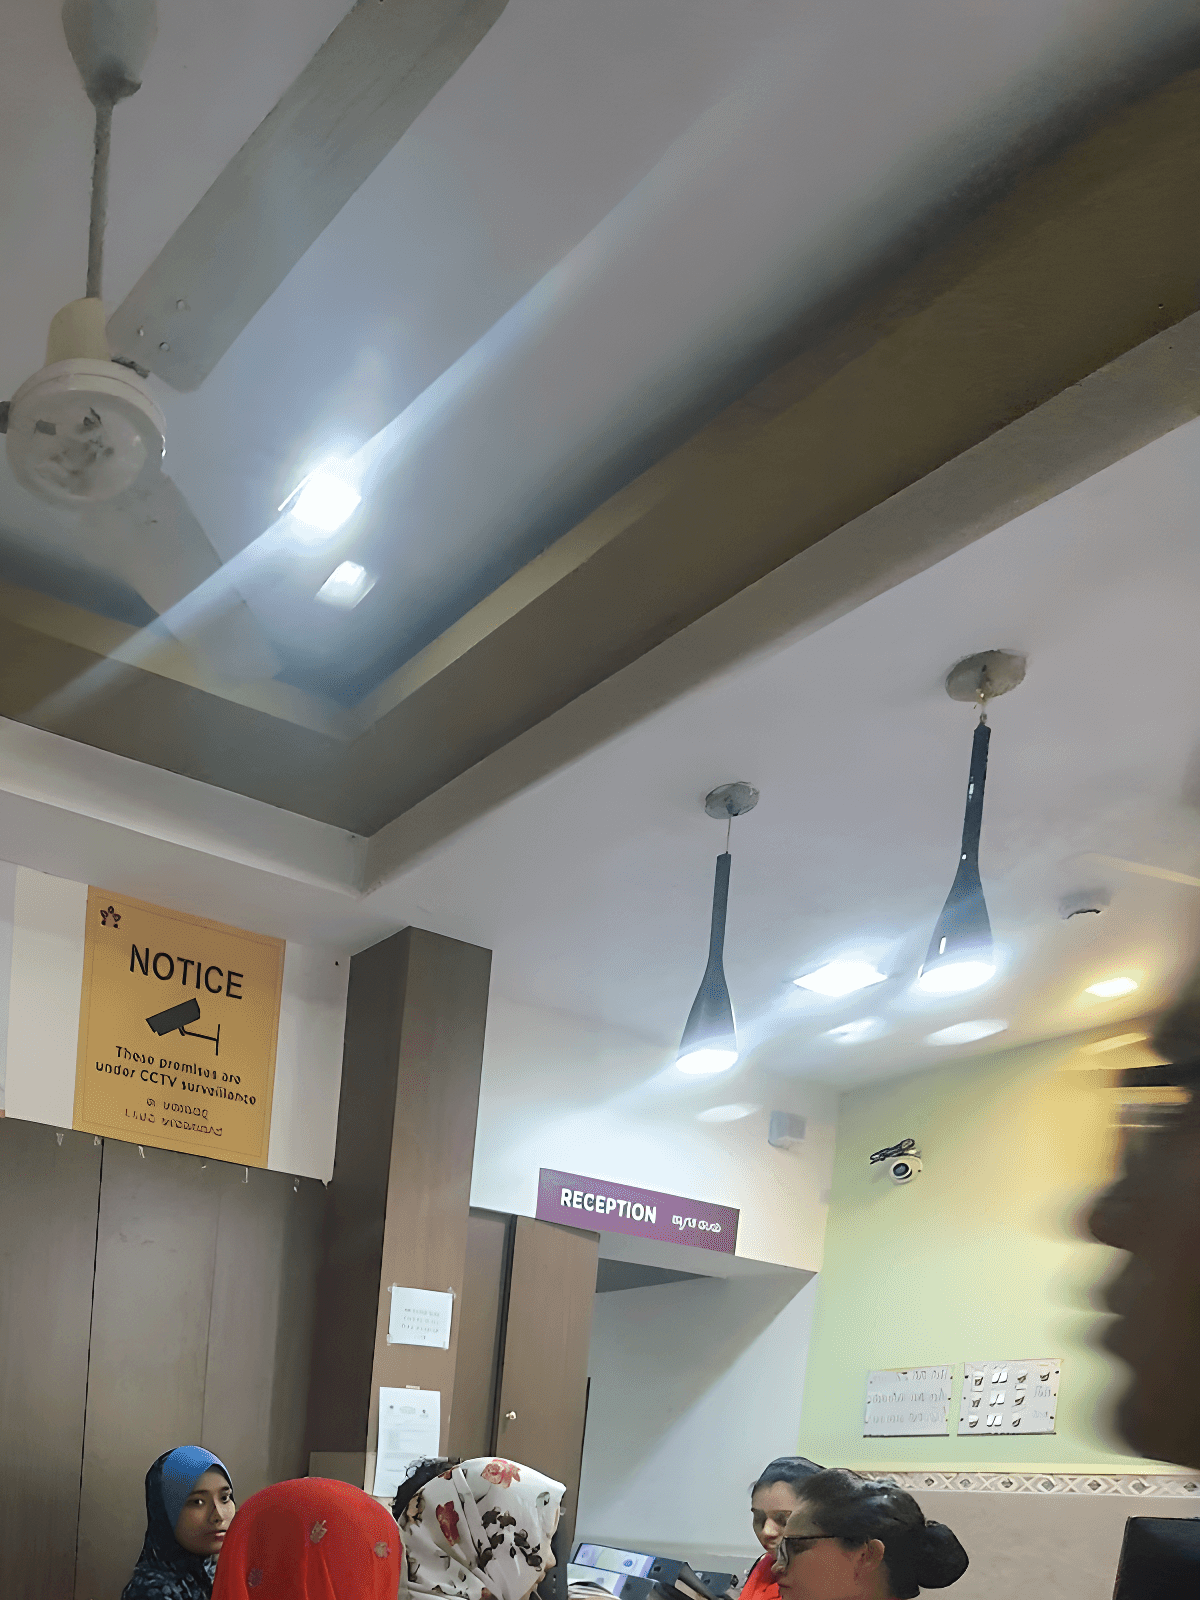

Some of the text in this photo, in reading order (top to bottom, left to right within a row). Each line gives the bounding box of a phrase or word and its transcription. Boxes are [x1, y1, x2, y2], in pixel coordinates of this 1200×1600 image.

[129, 943, 244, 1000] NOTICE
[140, 1069, 177, 1088] CCTV
[560, 1188, 657, 1224] RECEPTION
